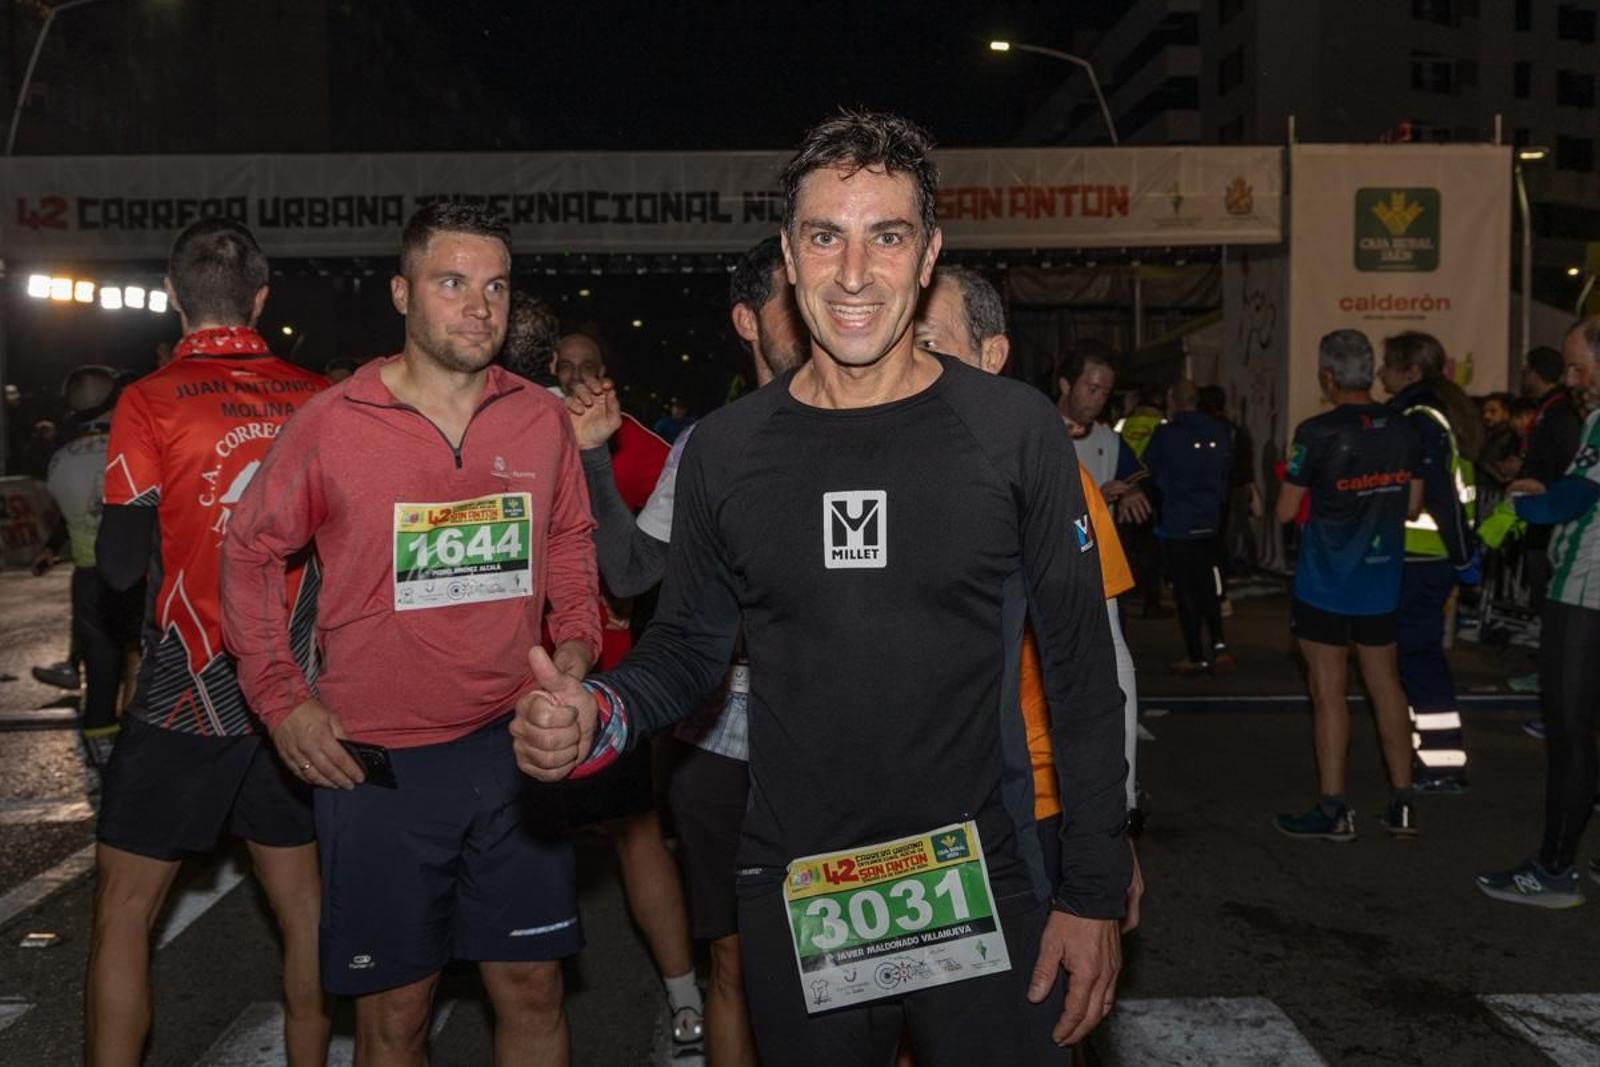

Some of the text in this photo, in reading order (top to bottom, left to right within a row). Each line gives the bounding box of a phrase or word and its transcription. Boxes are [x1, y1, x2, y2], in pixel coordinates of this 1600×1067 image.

[16, 197, 68, 230] 42
[77, 197, 246, 229] CARRERA
[258, 195, 402, 228] URBANA
[937, 185, 1129, 221] SAN ANTON
[1339, 292, 1451, 311] calderón
[177, 380, 229, 398] JUAN
[221, 402, 294, 418] MOLINA
[408, 522, 522, 567] 1644
[832, 549, 879, 560] MILLET
[823, 858, 859, 885] 42
[859, 865, 885, 879] SAN
[806, 868, 971, 950] 3031
[836, 924, 973, 961] JAVIER MALDONADO VILLANUEVA
